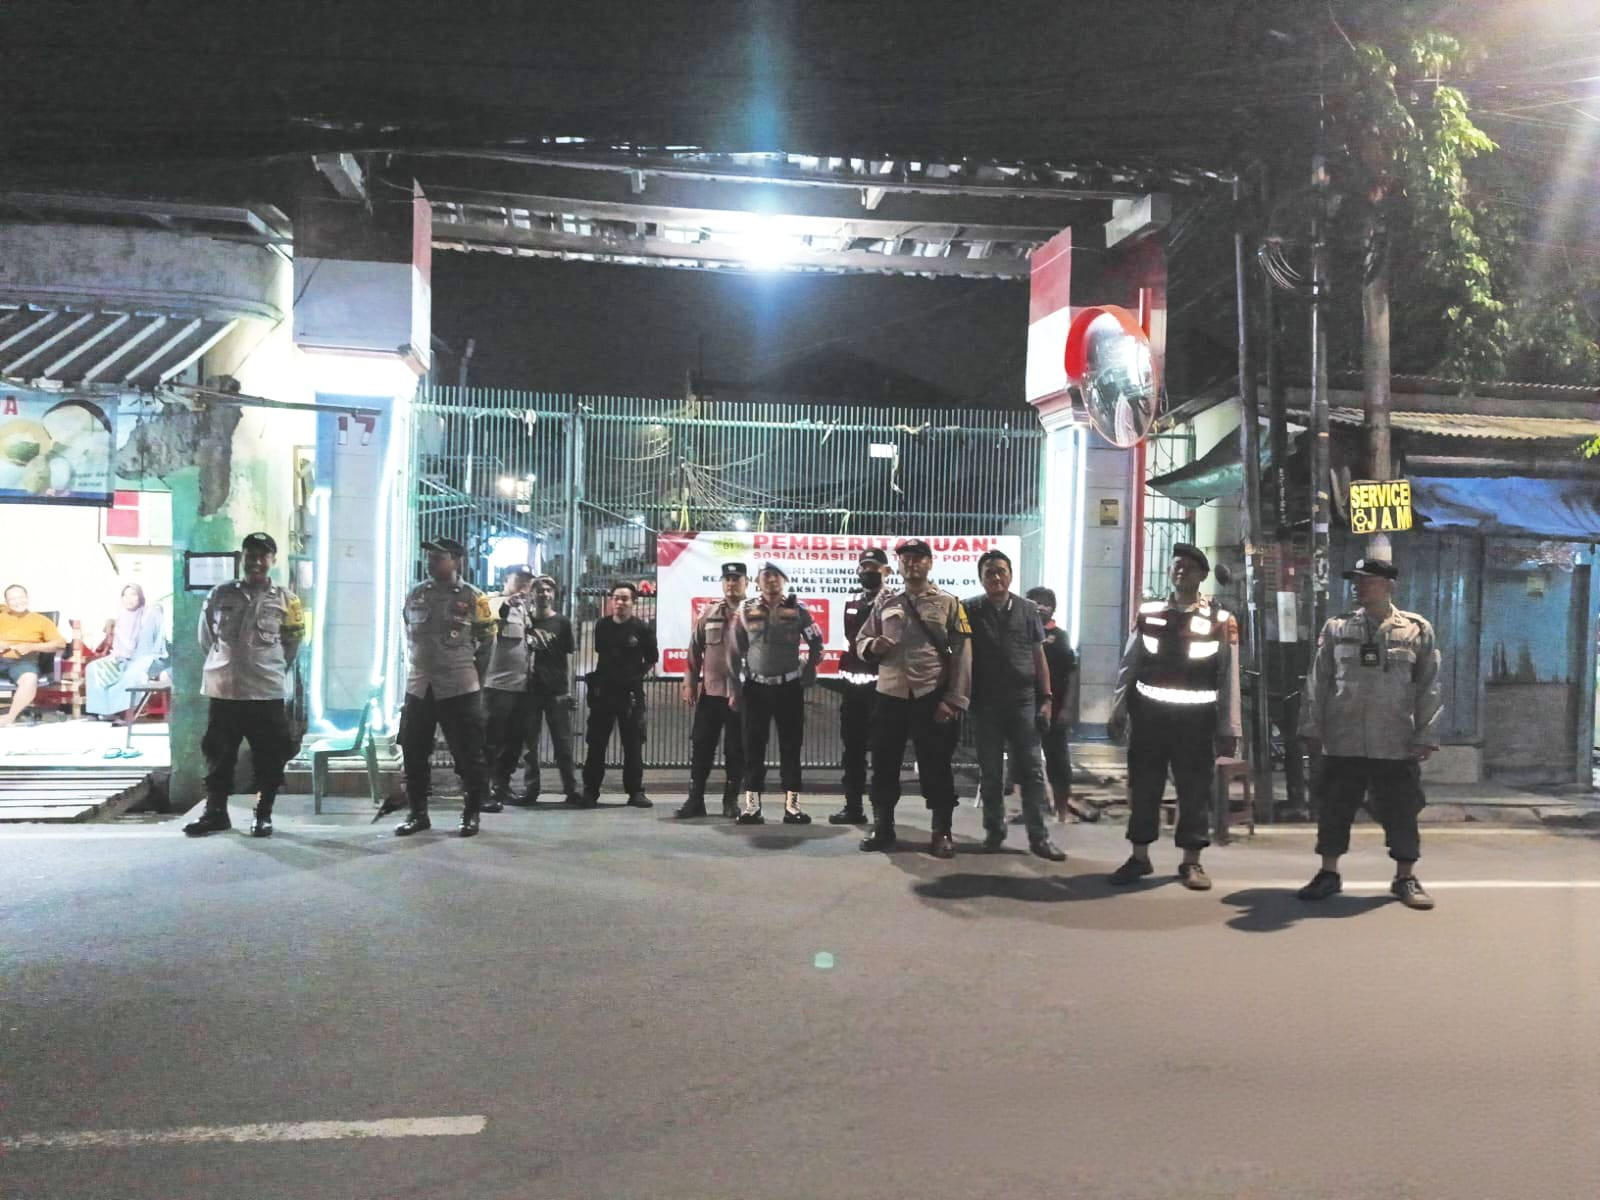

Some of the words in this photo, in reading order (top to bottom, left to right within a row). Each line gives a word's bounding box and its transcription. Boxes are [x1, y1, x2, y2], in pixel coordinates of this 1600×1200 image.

[1351, 483, 1410, 508] SERVICE
[1368, 506, 1413, 530] JAM
[753, 535, 998, 552] PEMBERITUAN!
[753, 552, 844, 561] SOSIALISASI
[943, 554, 979, 562] PORT
